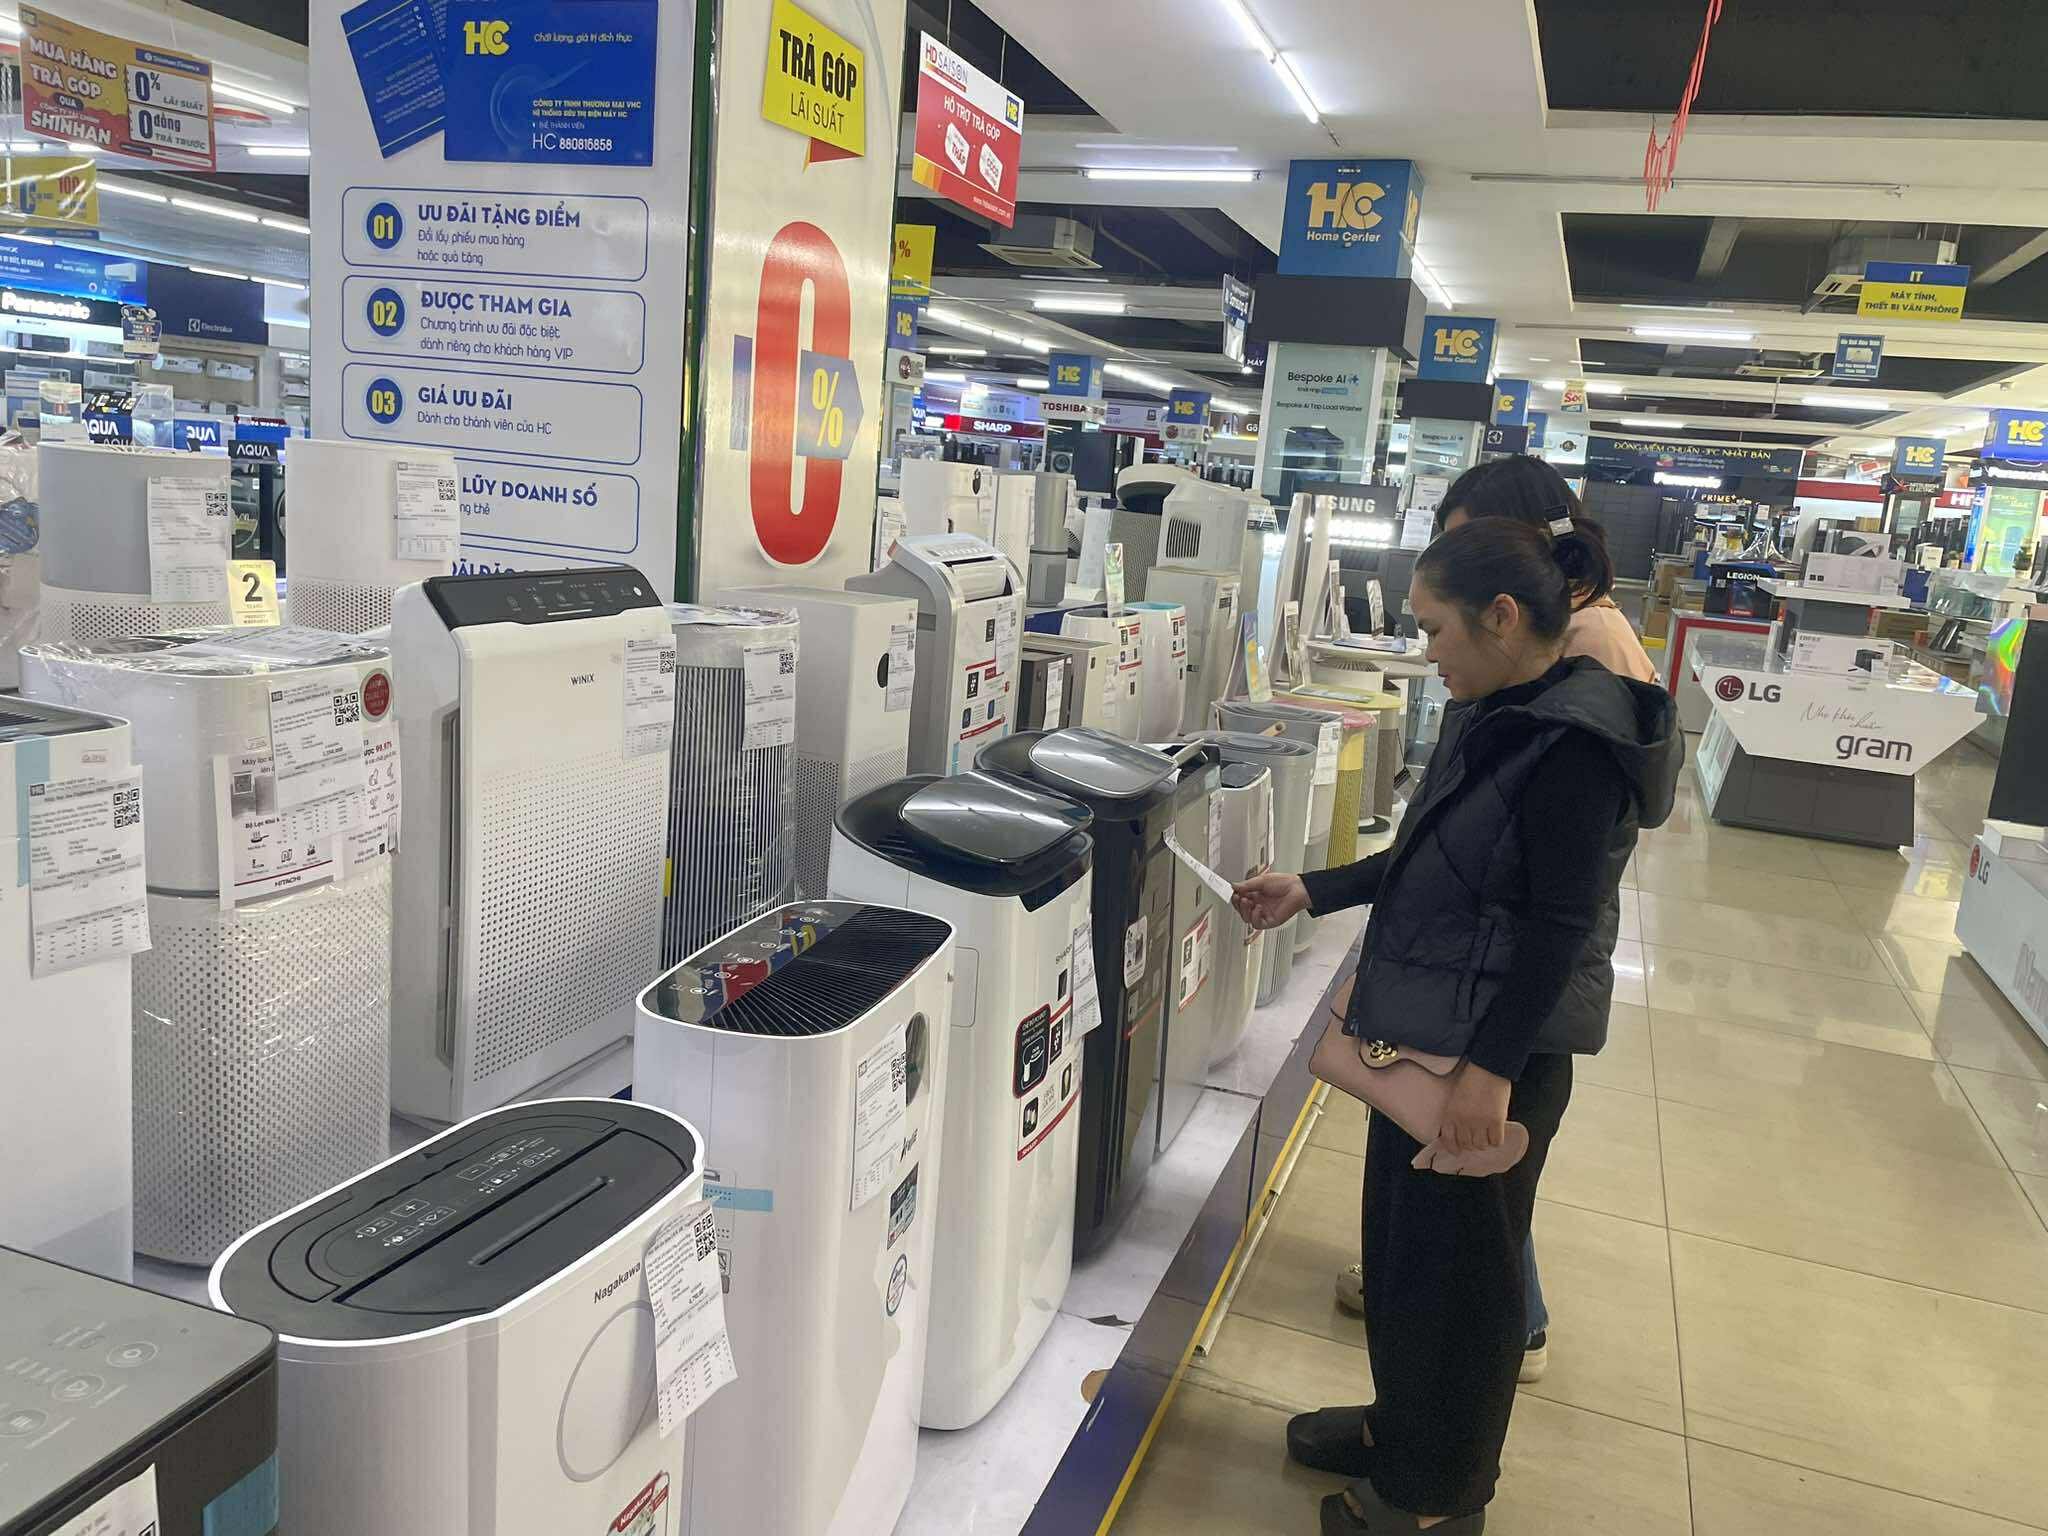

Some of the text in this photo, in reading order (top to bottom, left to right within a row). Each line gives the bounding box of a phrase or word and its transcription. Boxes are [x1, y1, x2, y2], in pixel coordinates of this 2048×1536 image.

[463, 20, 510, 55] HC
[30, 36, 118, 80] MUA HÀNG
[779, 29, 815, 87] TRẢ
[822, 50, 857, 103] GÓP
[67, 76, 102, 99] GÓP
[59, 96, 77, 108] QUA
[790, 91, 845, 136] LÃI SUẤT
[31, 110, 112, 145] SHINHAN
[533, 133, 556, 150] HC
[418, 201, 580, 228] ƯU ĐÃI TẶNG ĐIỂM
[1306, 182, 1385, 229] HC
[373, 214, 394, 240] 01
[1307, 231, 1380, 243] Home Center
[451, 231, 476, 246] phiếu
[478, 235, 500, 245] mua
[502, 233, 525, 248] hàng
[417, 248, 439, 263] hoặc
[441, 251, 459, 265] quà
[1909, 271, 1923, 282] IT
[421, 290, 572, 317] ĐƯỢC THAM GIA
[1865, 300, 1888, 310] THIẾT
[1925, 304, 1959, 314] PHÒNG
[1890, 291, 1937, 302] MÁY TÍNH,
[372, 301, 397, 327] 02
[420, 316, 457, 334] Chương
[459, 318, 484, 333] trình
[420, 337, 574, 361] dành riêng cho khách hàng VIP
[1434, 328, 1482, 357] HC
[1057, 365, 1081, 382] HC
[1287, 371, 1347, 384] Bespoke AI
[371, 390, 395, 415] 03
[418, 383, 512, 410] GIÁ ƯU ĐÃI
[1276, 401, 1302, 409] Bespoke
[1042, 403, 1086, 413] TOSHIBA
[1174, 400, 1195, 415] HC
[417, 411, 441, 424] Dành
[444, 414, 460, 426] cho
[463, 415, 491, 429] thành
[493, 418, 514, 431] viên
[537, 422, 552, 435] HC
[973, 420, 1011, 433] SHARP
[2008, 419, 2046, 442] HC
[237, 444, 271, 457] AQUA
[1906, 446, 1935, 463] HC
[462, 474, 598, 507] LŨY DOANH SỐ
[460, 503, 490, 515] ng thẻ
[1327, 494, 1376, 513] SUNG
[1727, 571, 1760, 581] LEGION
[242, 572, 263, 602] 2
[1730, 608, 1752, 616] Lenovo
[571, 673, 595, 685] WINIX
[1749, 682, 1781, 703] LG
[1836, 734, 1912, 762] gram
[1978, 855, 1990, 885] LG
[275, 875, 301, 887] HITACHI
[593, 1260, 641, 1304] Nagakawa
[620, 1486, 653, 1527] Nagakawa
